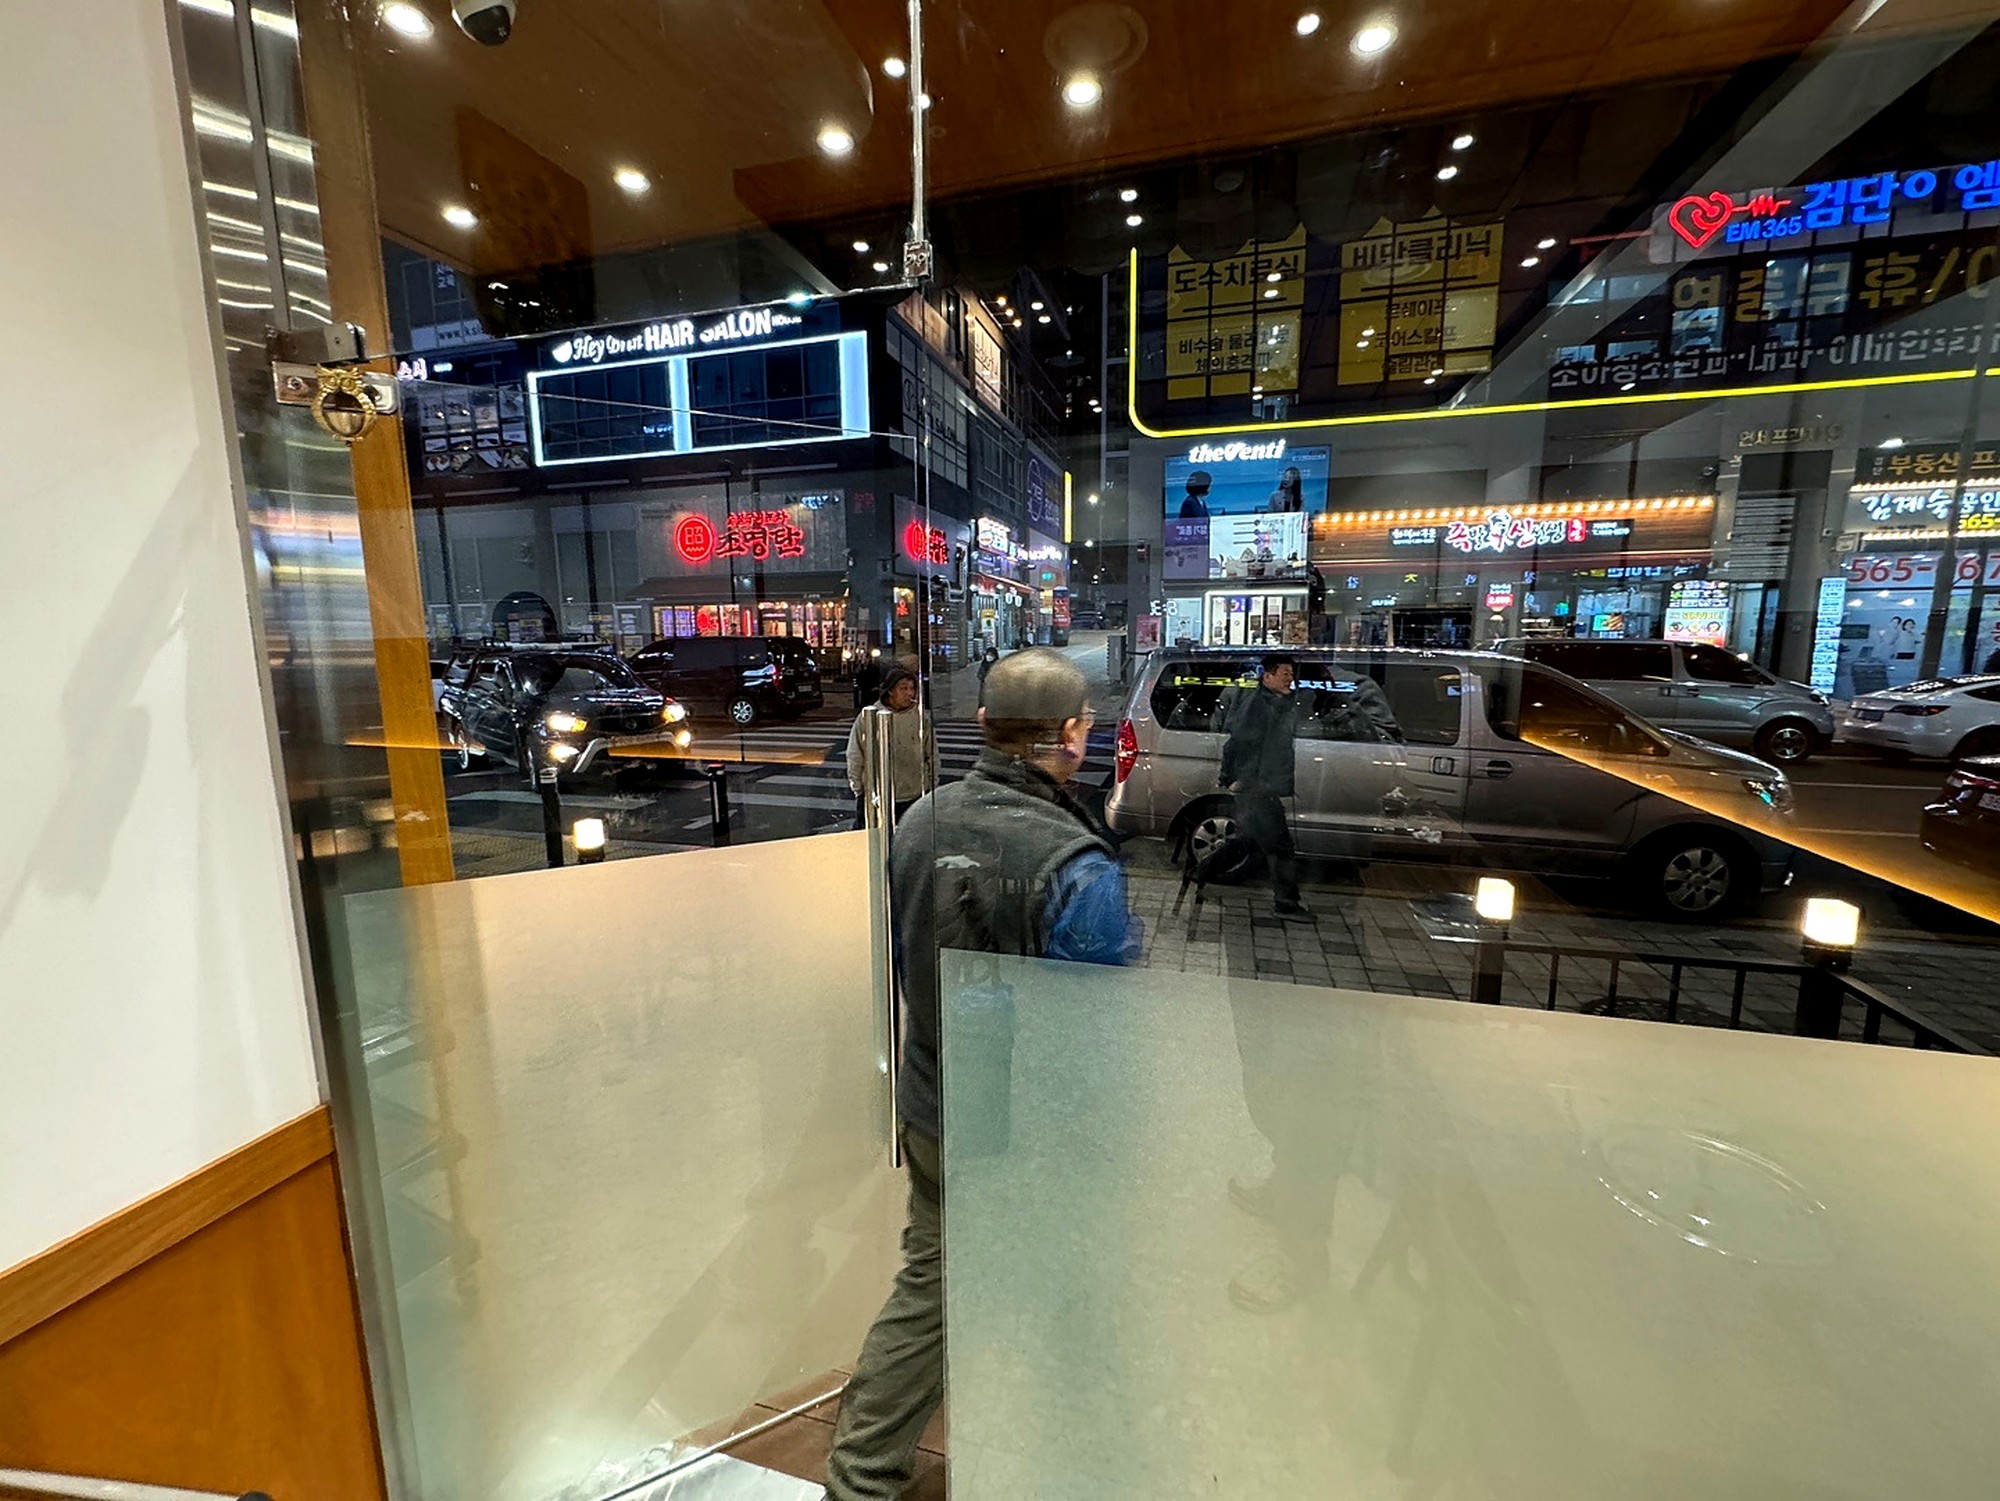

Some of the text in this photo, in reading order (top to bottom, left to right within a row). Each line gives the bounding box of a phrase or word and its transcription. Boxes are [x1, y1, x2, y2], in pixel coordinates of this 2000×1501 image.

[1724, 215, 1803, 245] EM365
[644, 319, 695, 352] HAIR
[1179, 335, 1224, 354] 비수술
[1887, 451, 1961, 476] 부동산
